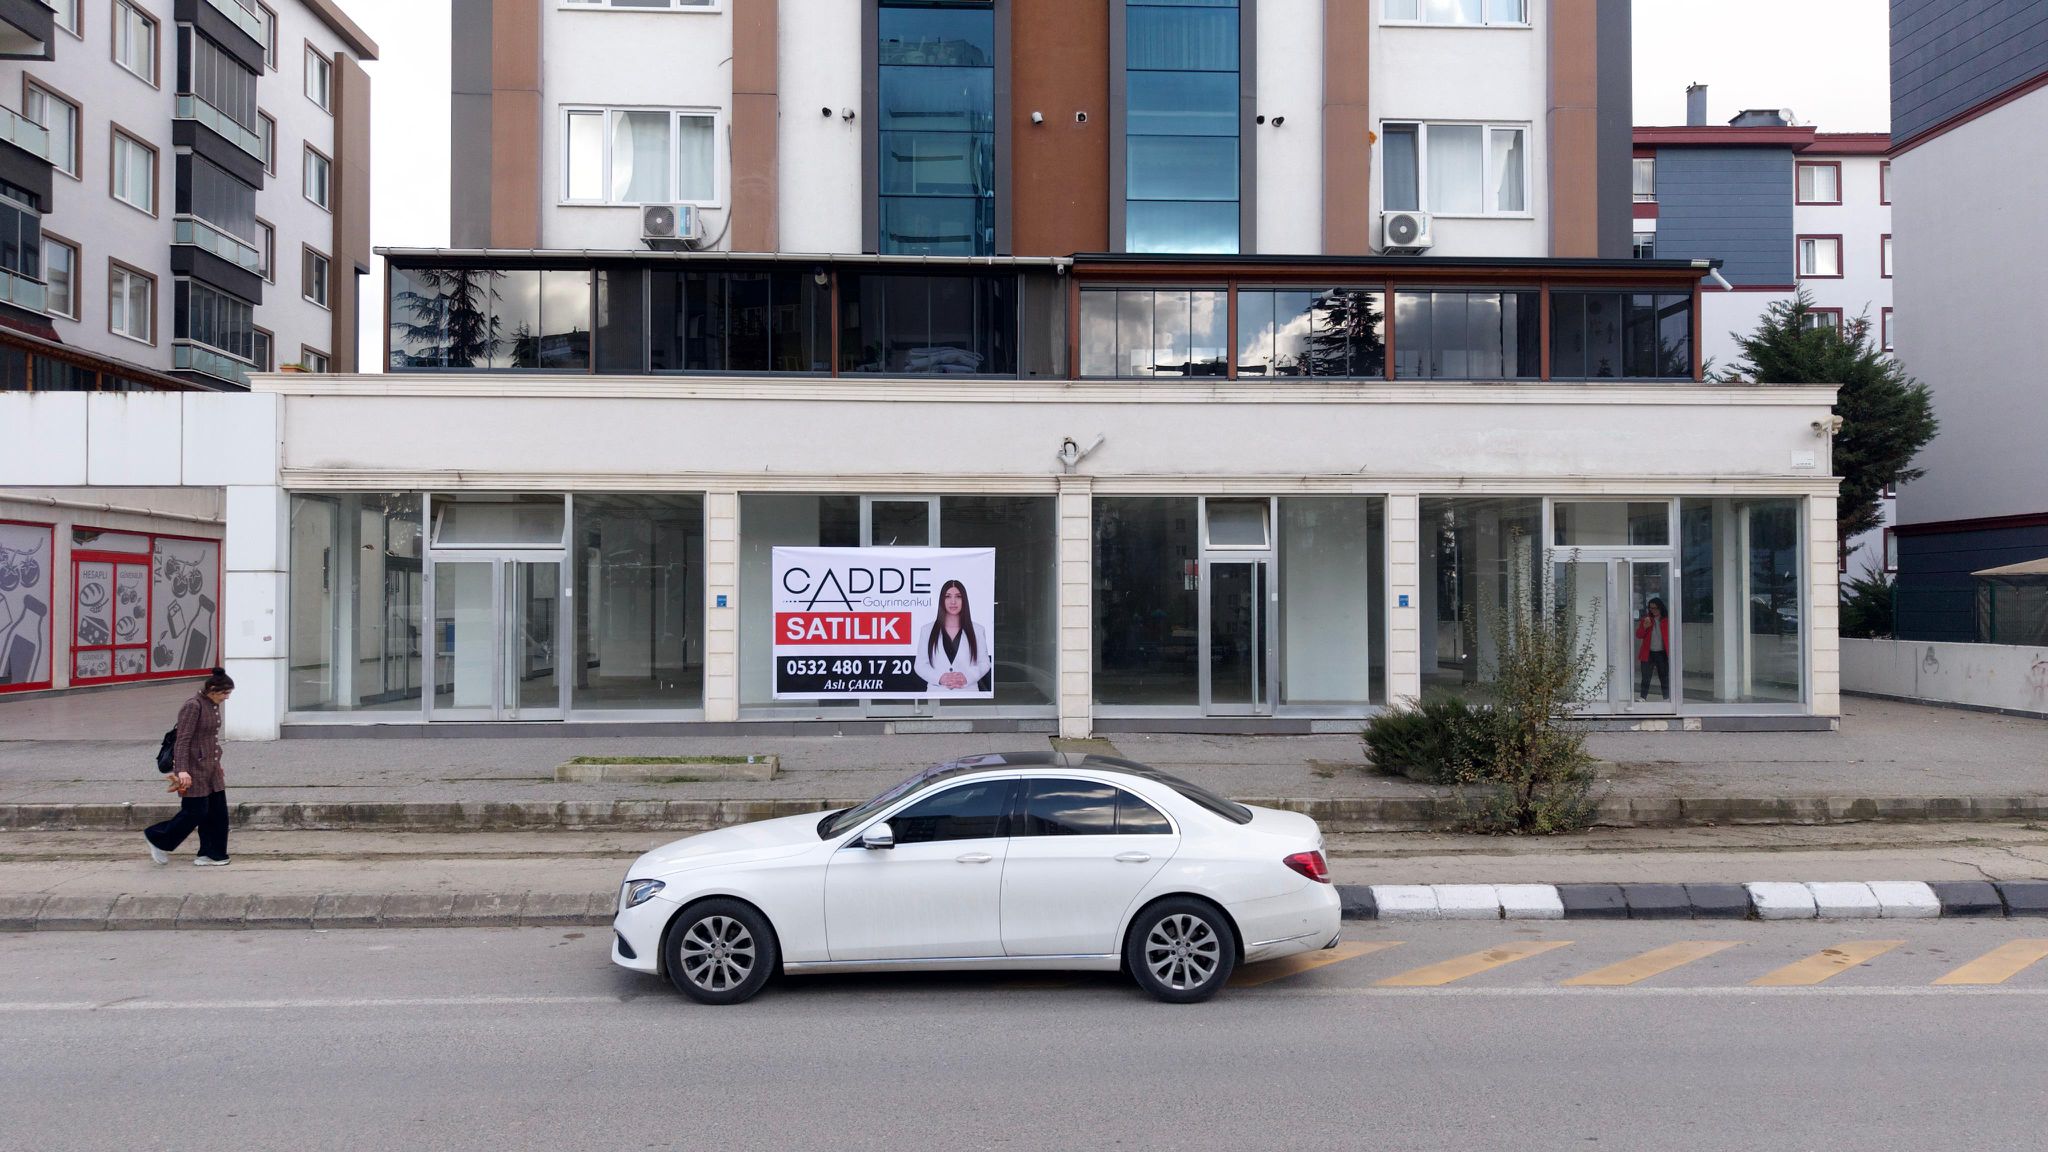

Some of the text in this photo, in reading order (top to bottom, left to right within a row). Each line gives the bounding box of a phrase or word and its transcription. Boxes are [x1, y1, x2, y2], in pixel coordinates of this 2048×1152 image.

[153, 543, 163, 586] TAZE
[783, 567, 931, 611] CADDE
[786, 617, 901, 640] SATILIK
[786, 659, 912, 675] 0532 480 17 20
[823, 678, 884, 692] Aslı ÇAKIR
